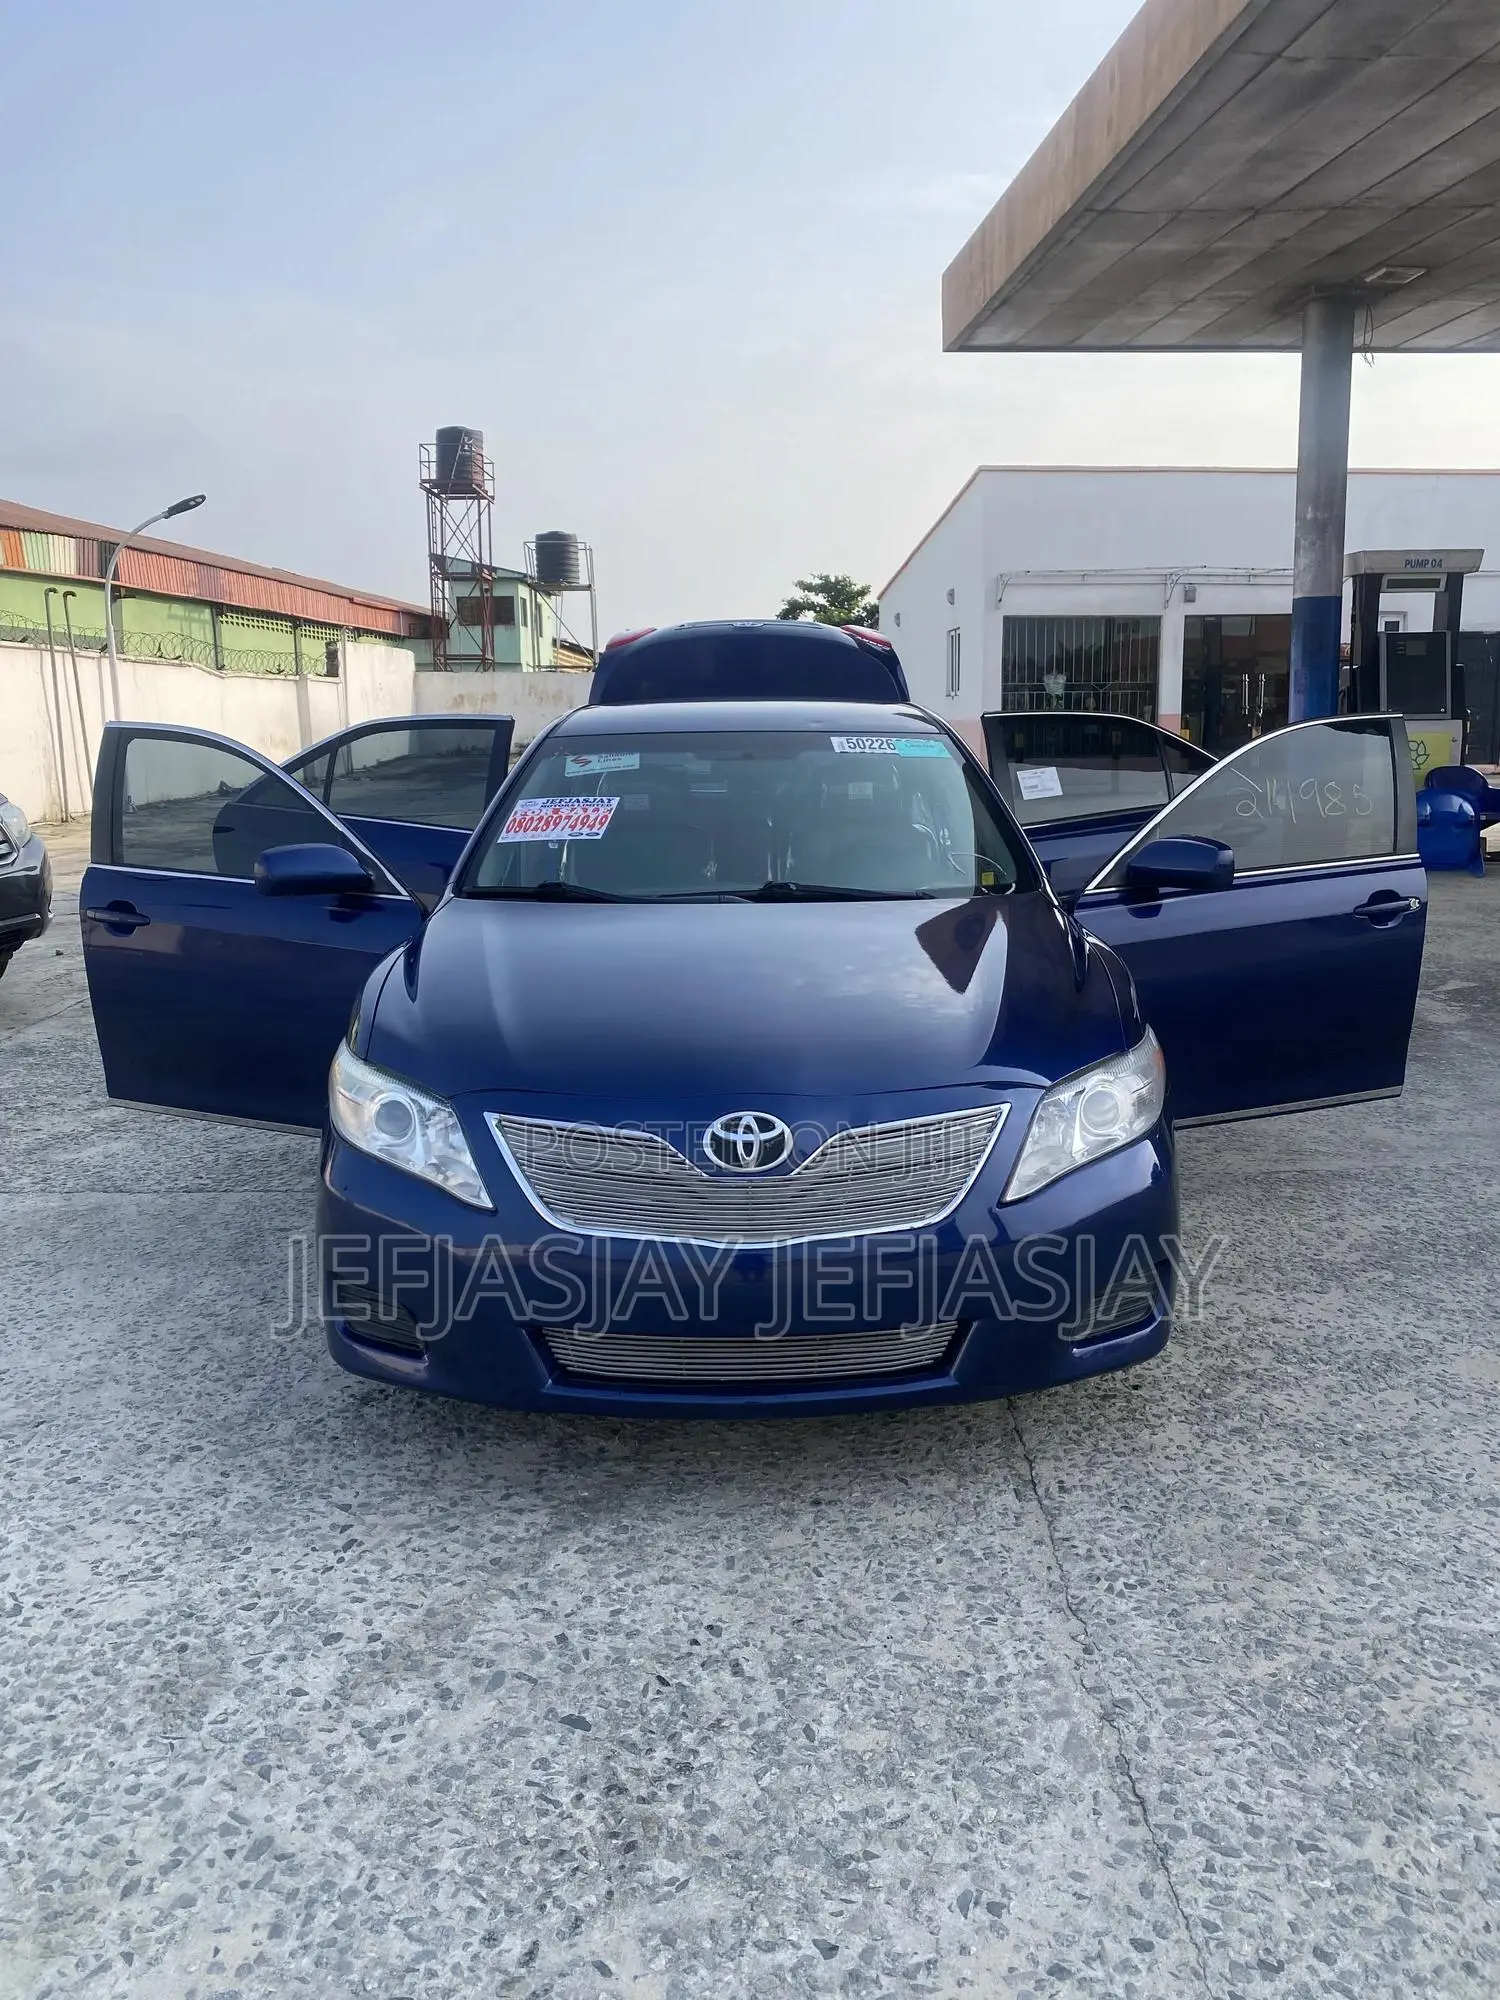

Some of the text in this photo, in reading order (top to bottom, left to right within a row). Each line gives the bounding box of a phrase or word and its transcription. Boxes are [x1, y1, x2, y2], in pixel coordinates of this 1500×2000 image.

[1404, 558, 1443, 569] PUMP 04
[845, 737, 912, 751] 50226
[505, 813, 609, 834] 08028974949
